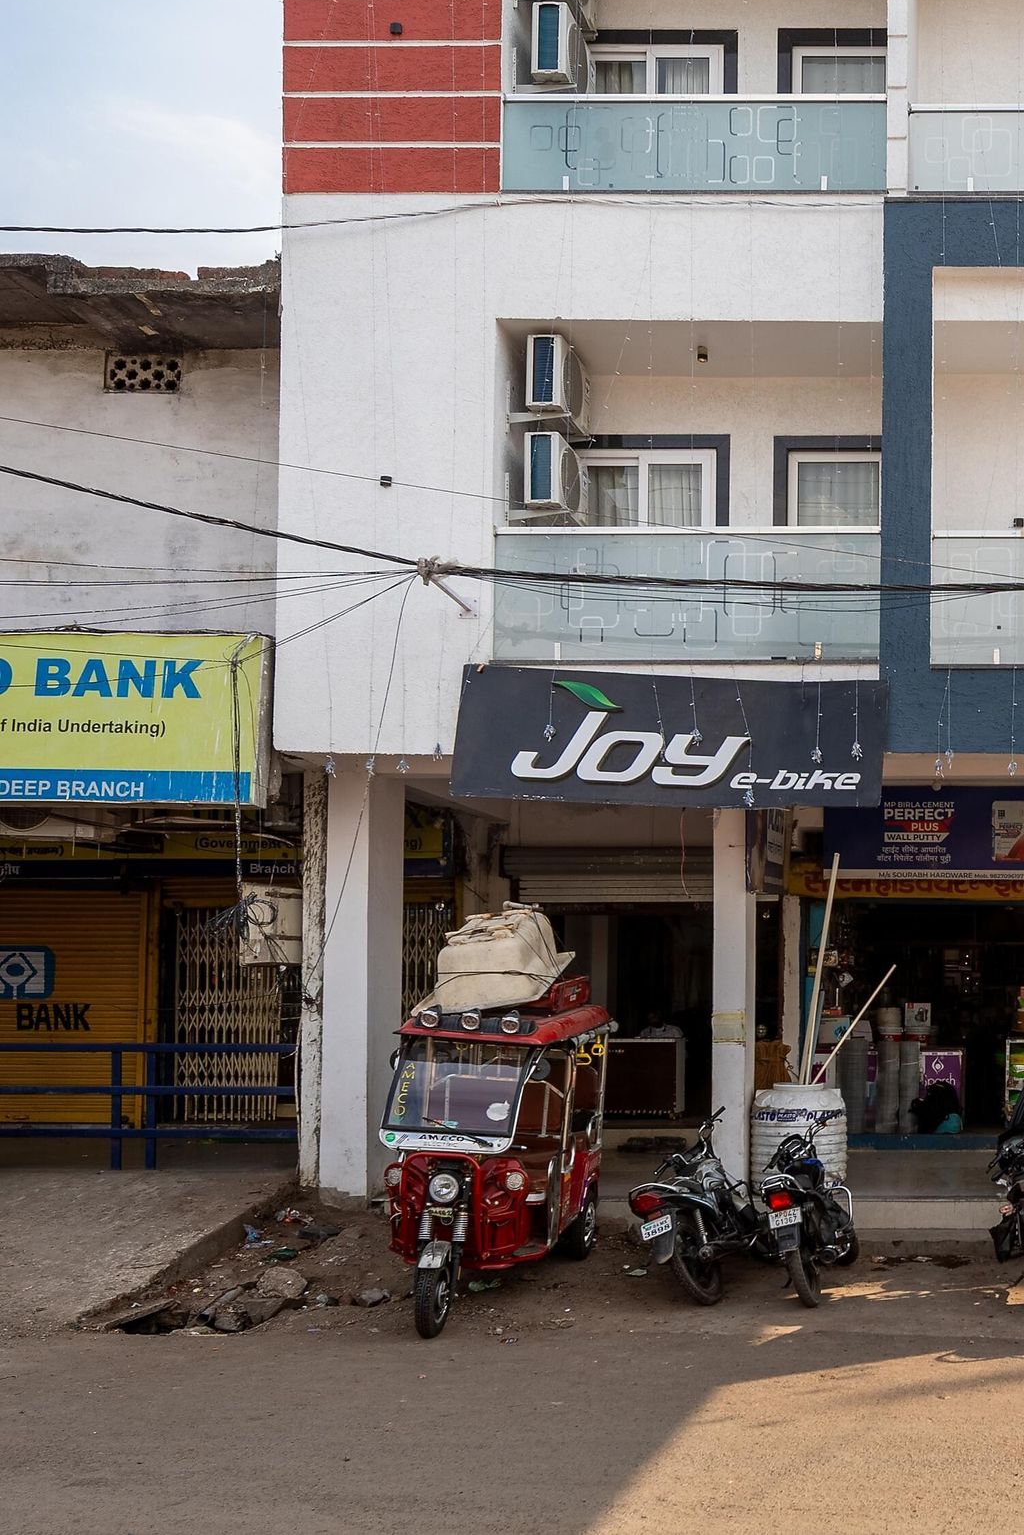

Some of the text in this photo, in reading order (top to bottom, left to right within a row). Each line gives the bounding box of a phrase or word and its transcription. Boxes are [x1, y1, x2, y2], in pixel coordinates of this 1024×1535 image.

[34, 657, 205, 699] BANK
[11, 718, 52, 732] India
[57, 718, 167, 738] Undertaking)
[730, 769, 863, 791] e-bike
[56, 780, 145, 797] BRANCH
[883, 808, 955, 820] PERFECT
[911, 822, 940, 831] PLUS
[886, 833, 942, 841] WALL PUTTY
[249, 863, 296, 874] Branch
[892, 871, 929, 879] SOURABH
[929, 871, 973, 879] HARDWARE
[16, 1003, 92, 1032] BANK
[644, 1223, 671, 1239] 3898
